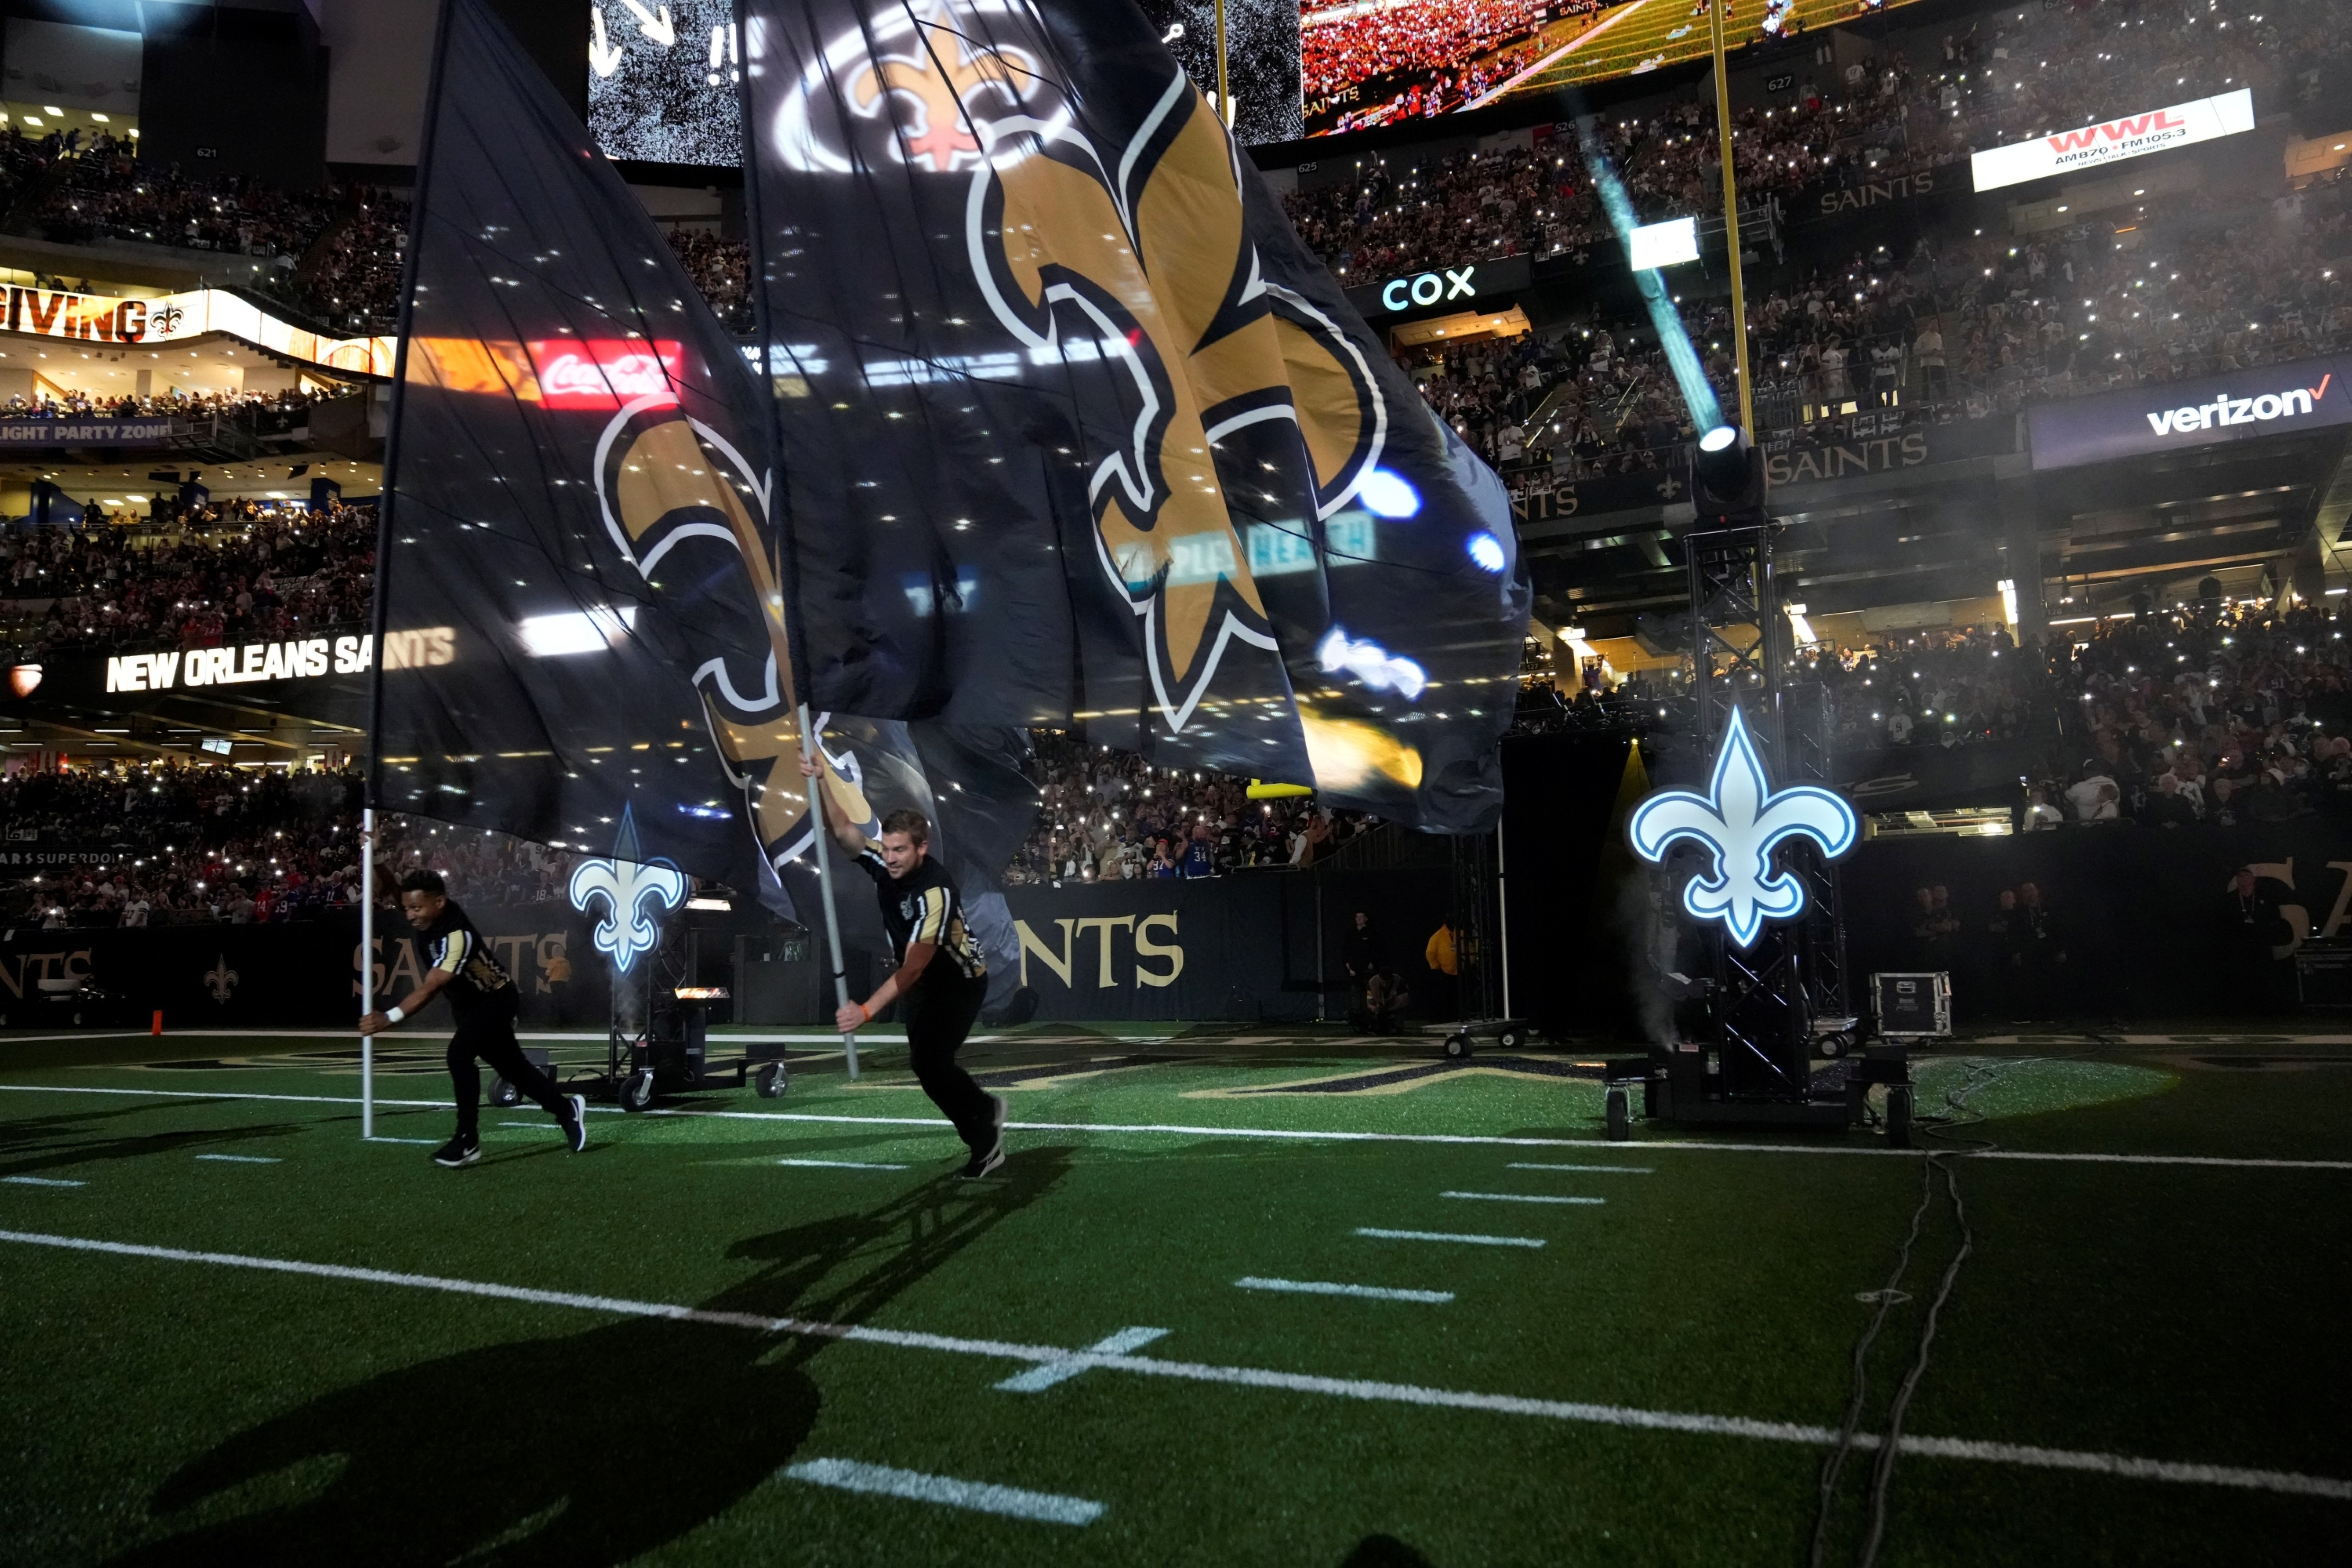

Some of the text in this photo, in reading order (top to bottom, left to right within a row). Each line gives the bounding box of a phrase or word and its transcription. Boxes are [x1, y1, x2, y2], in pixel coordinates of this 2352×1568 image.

[1768, 77, 1792, 90] 627
[197, 148, 217, 158] 621
[2047, 111, 2184, 153] WWL
[2132, 143, 2166, 154] SPORTS
[1299, 162, 1317, 173] 625
[1821, 172, 1934, 215] SAINTS
[1383, 266, 1475, 311] COX
[0, 286, 147, 343] IVING
[2147, 387, 2312, 436] verizon
[0, 426, 48, 441] IGHT
[54, 426, 119, 440] PARTY
[1768, 432, 1927, 487] SAINTS
[106, 627, 455, 693] NEW ORLEANS SANTS
[1194, 851, 1206, 862] 34
[536, 889, 547, 901] 18
[352, 930, 568, 996] SATS
